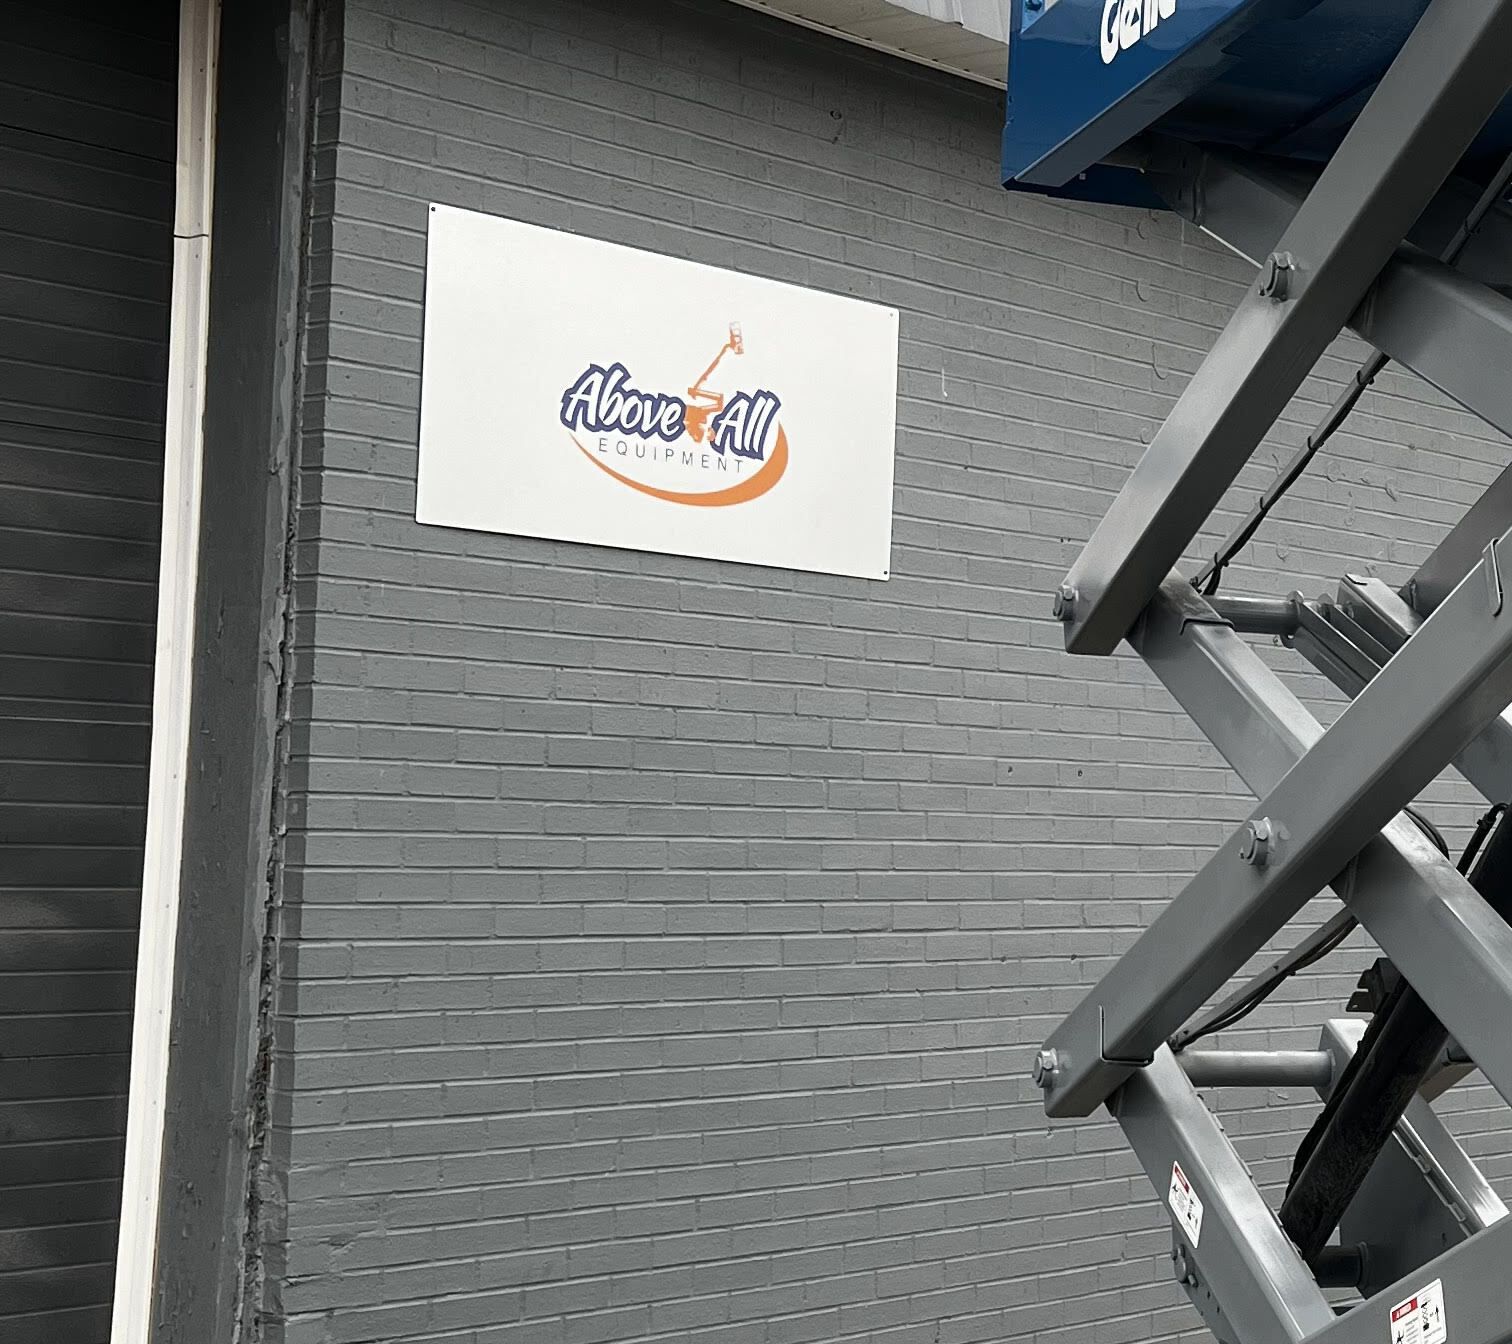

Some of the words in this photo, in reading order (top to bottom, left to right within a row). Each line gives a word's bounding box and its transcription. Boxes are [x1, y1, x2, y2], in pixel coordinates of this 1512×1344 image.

[560, 362, 687, 442] Above
[710, 389, 782, 461] All
[598, 437, 744, 473] EQUIPMENT
